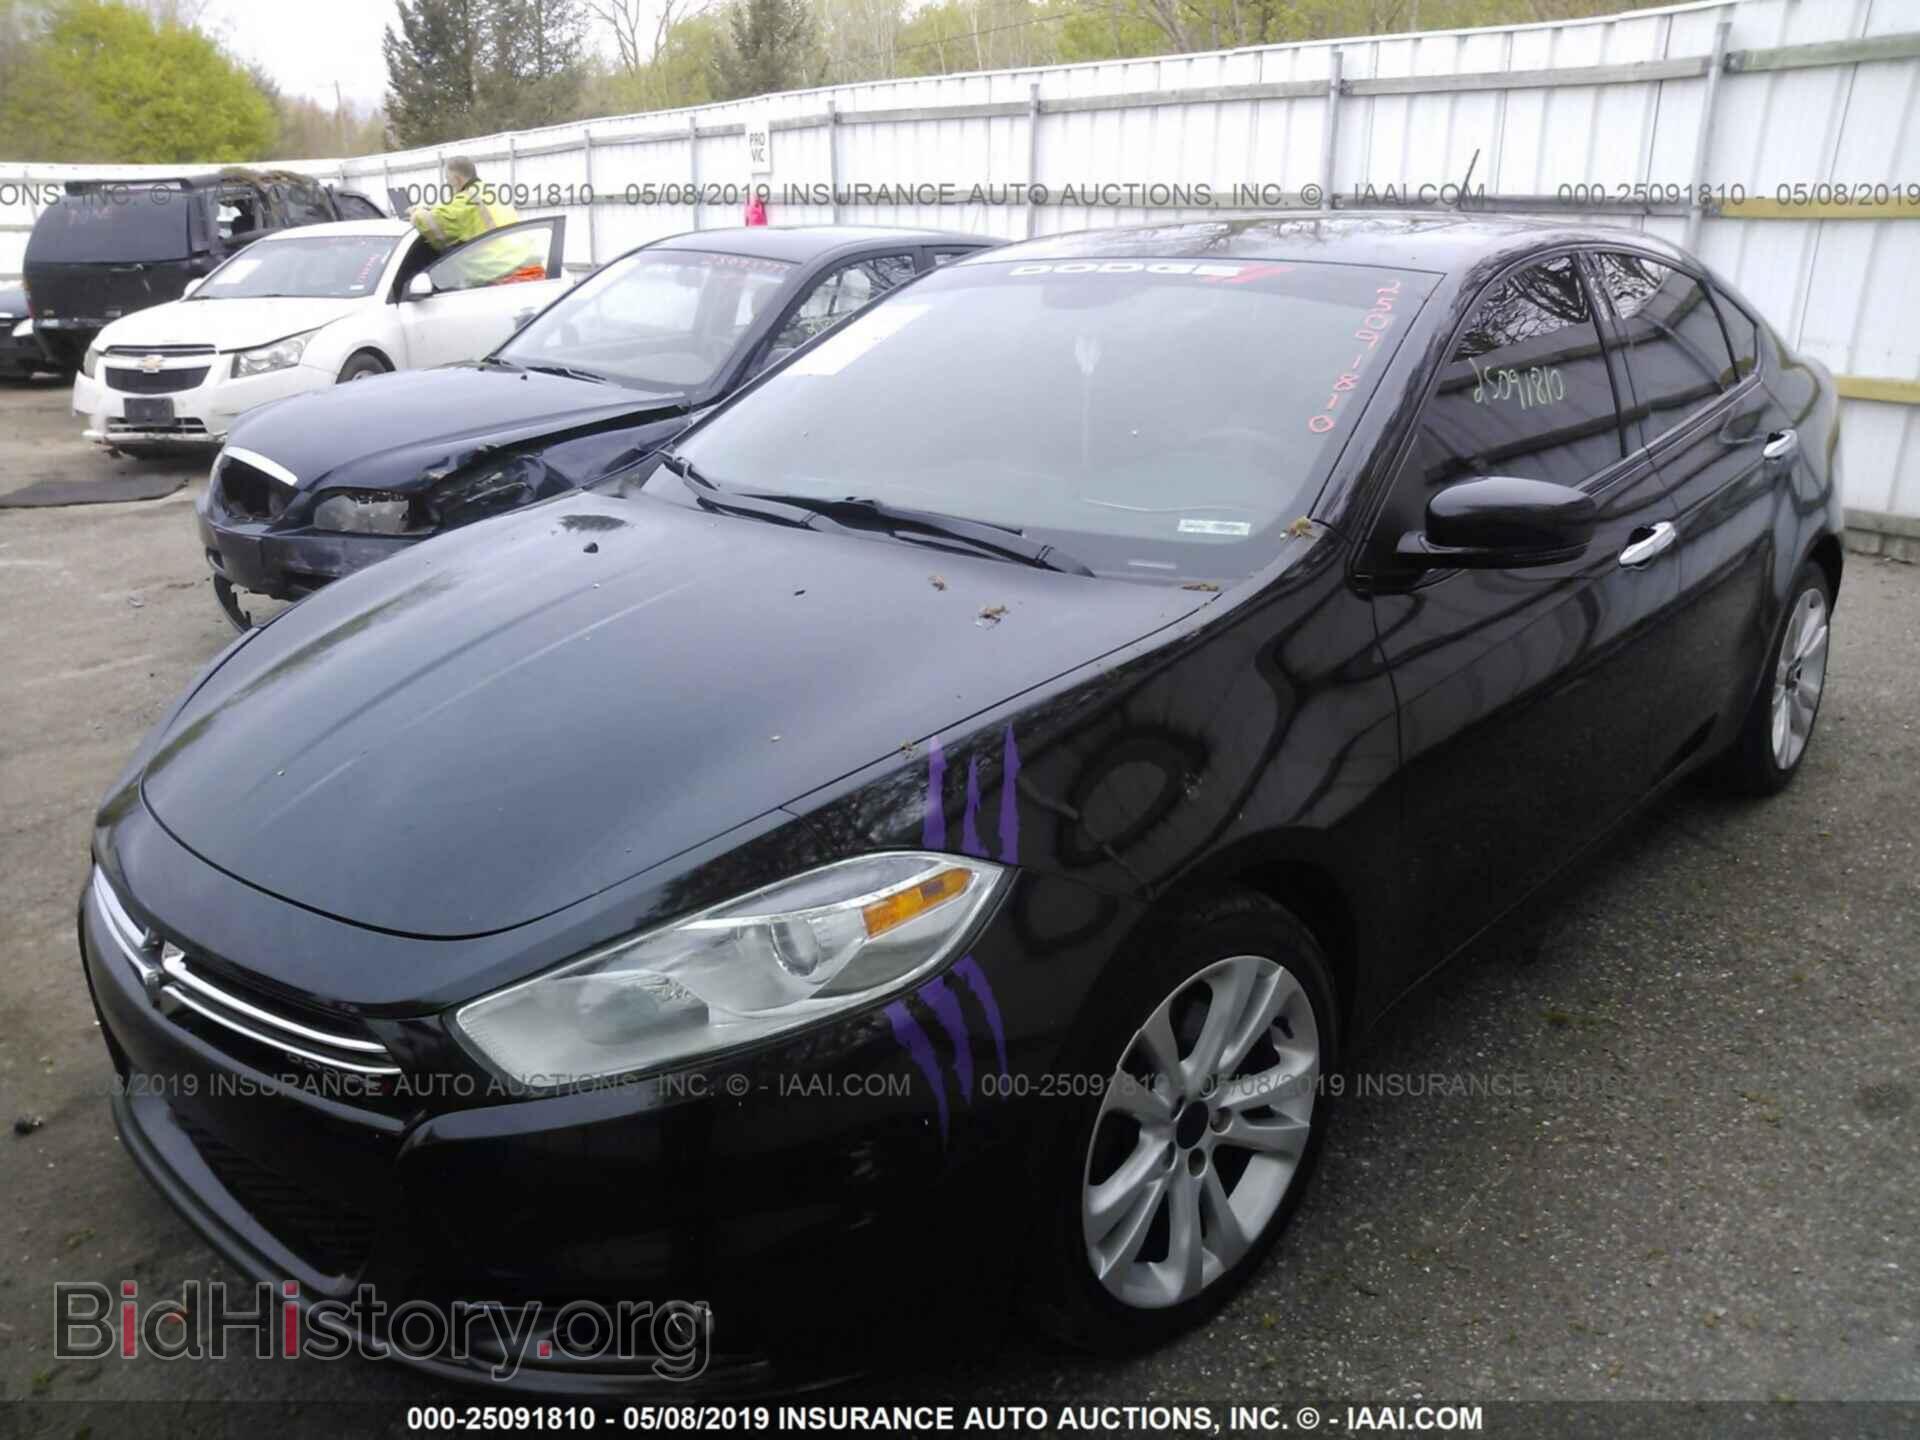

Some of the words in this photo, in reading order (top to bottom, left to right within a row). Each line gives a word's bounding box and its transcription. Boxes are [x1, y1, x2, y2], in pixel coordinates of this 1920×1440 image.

[750, 132, 766, 146] PRO
[751, 148, 766, 162] VIC
[1309, 279, 1401, 433] 25091810
[1468, 357, 1565, 410] 25091810
